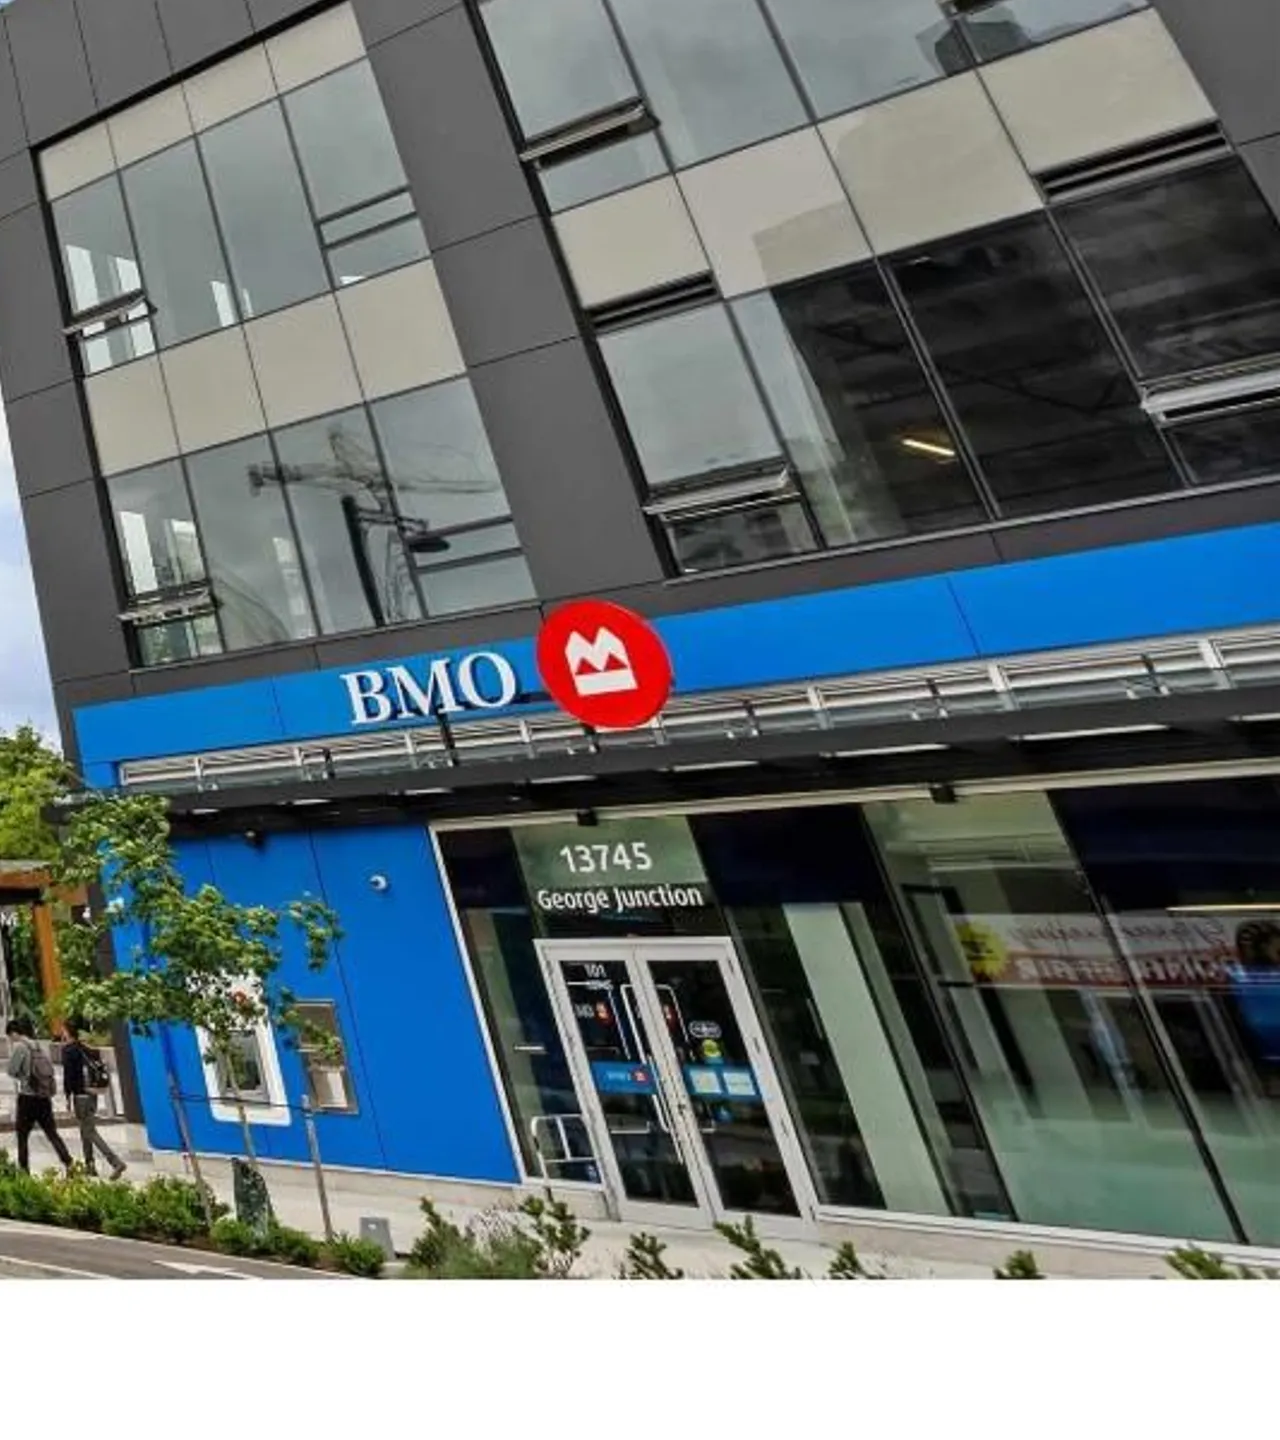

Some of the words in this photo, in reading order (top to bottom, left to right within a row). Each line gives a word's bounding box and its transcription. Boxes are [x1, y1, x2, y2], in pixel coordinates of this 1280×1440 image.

[341, 651, 516, 724] BMO
[559, 841, 653, 873] 13745
[537, 889, 610, 914] George
[613, 882, 705, 913] Junction
